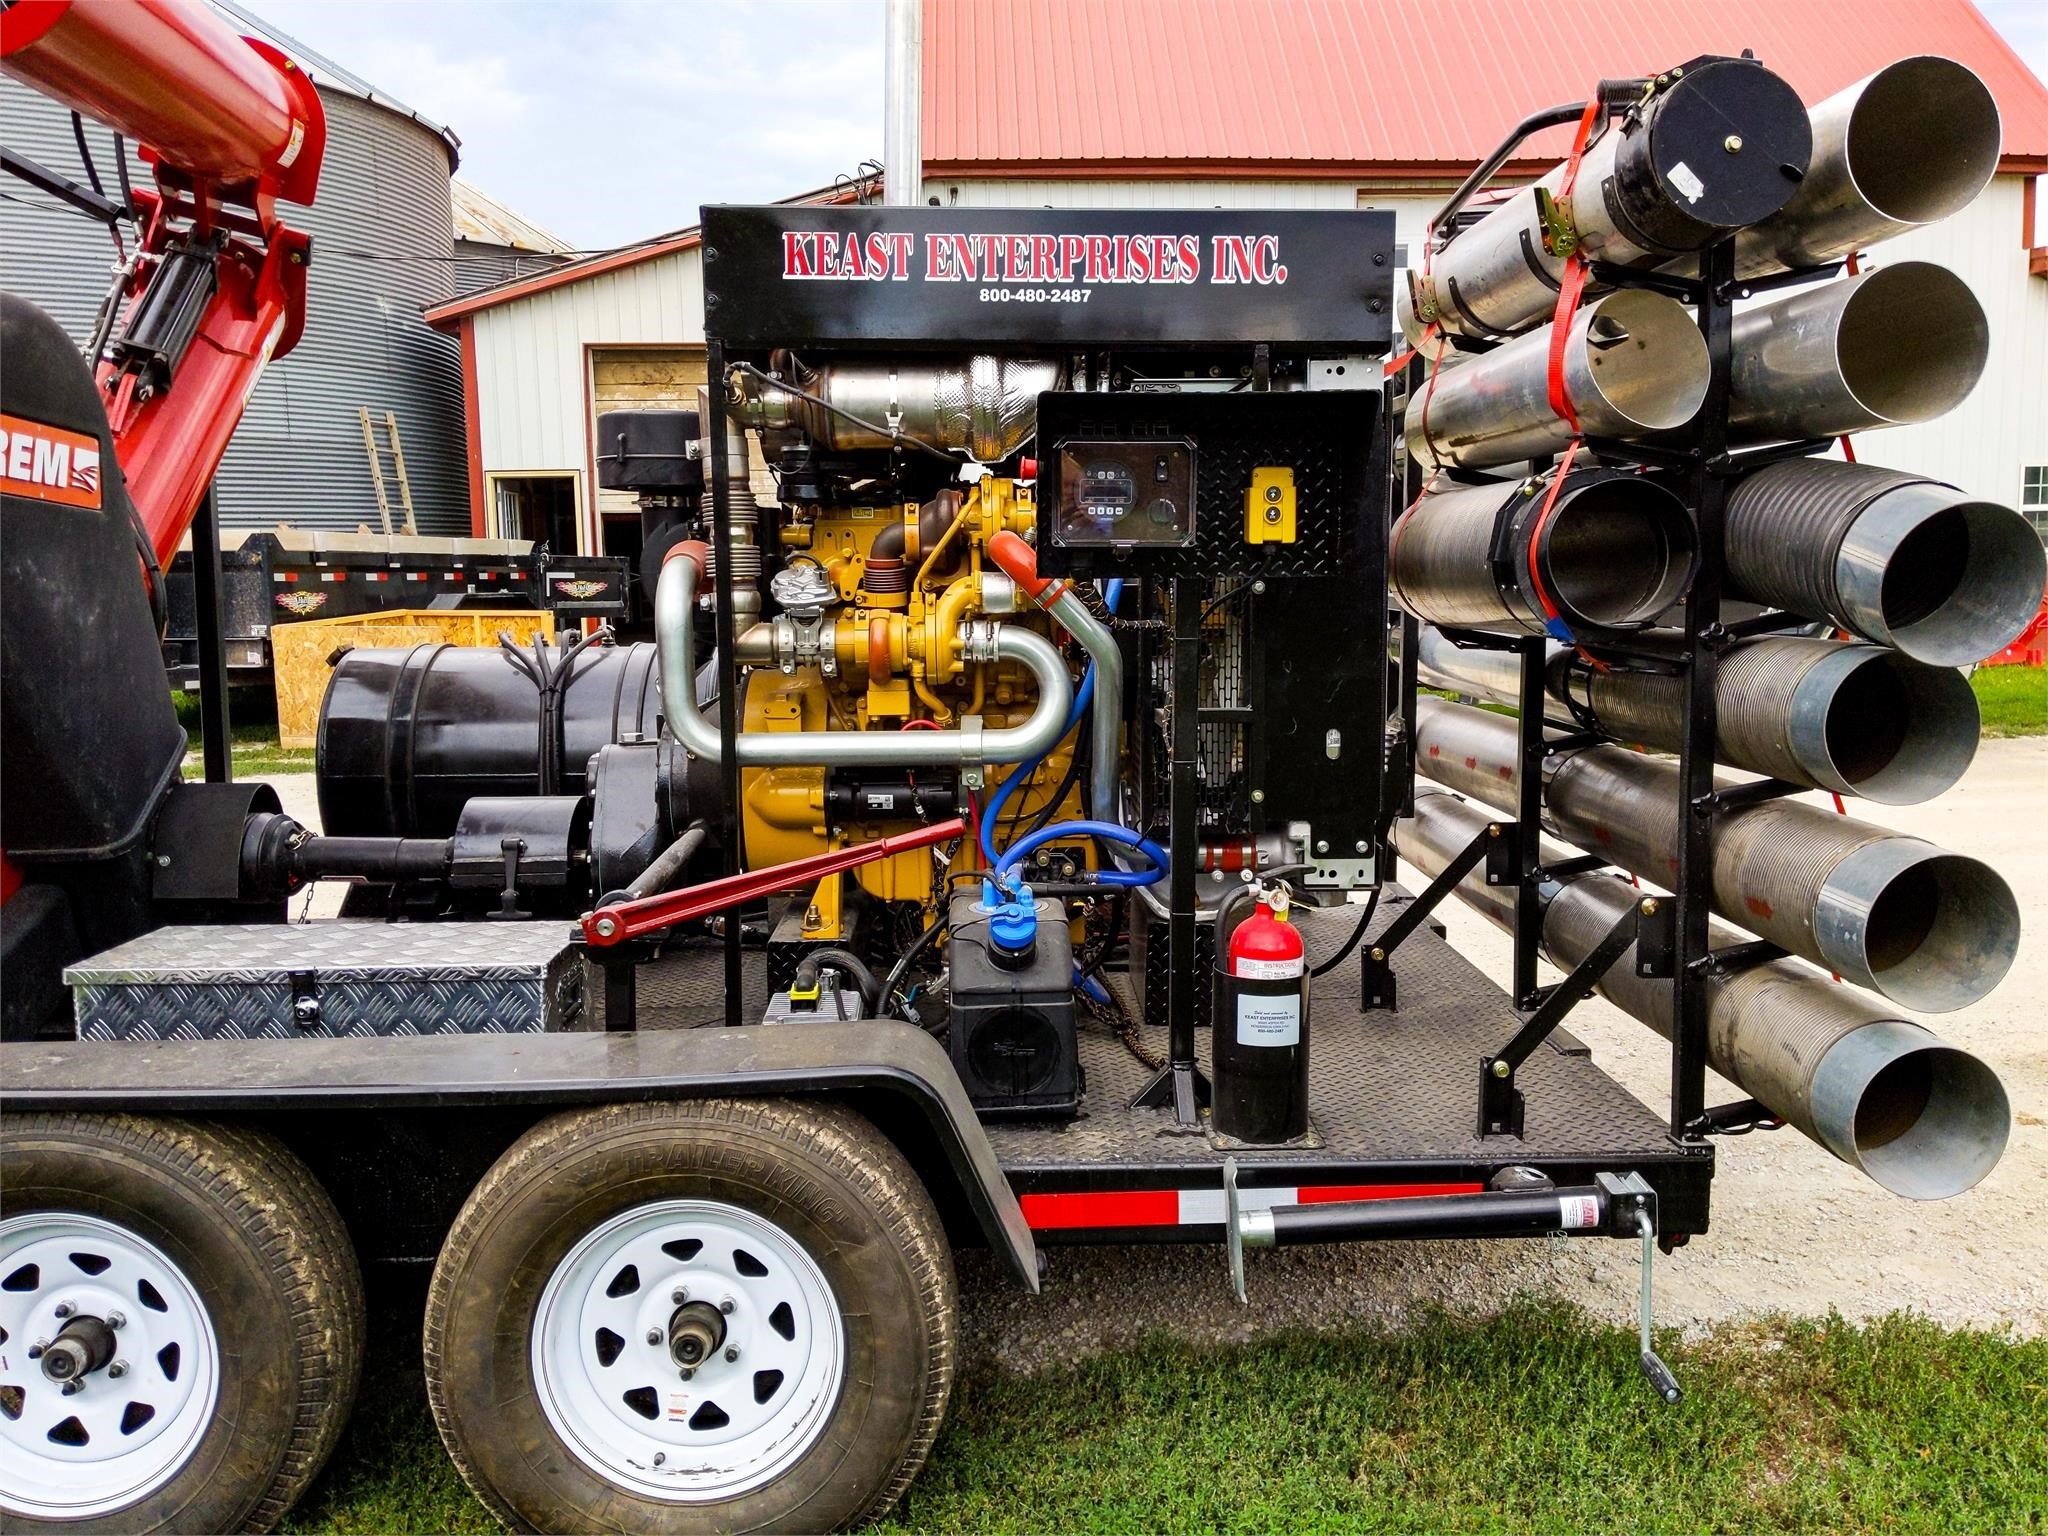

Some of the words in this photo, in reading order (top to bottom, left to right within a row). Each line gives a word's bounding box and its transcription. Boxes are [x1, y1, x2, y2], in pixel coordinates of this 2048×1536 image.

[782, 231, 914, 281] KEAST
[924, 233, 1200, 284] ENTERPRISES
[1210, 234, 1288, 285] INC.
[979, 288, 1092, 303] 800-480-2487
